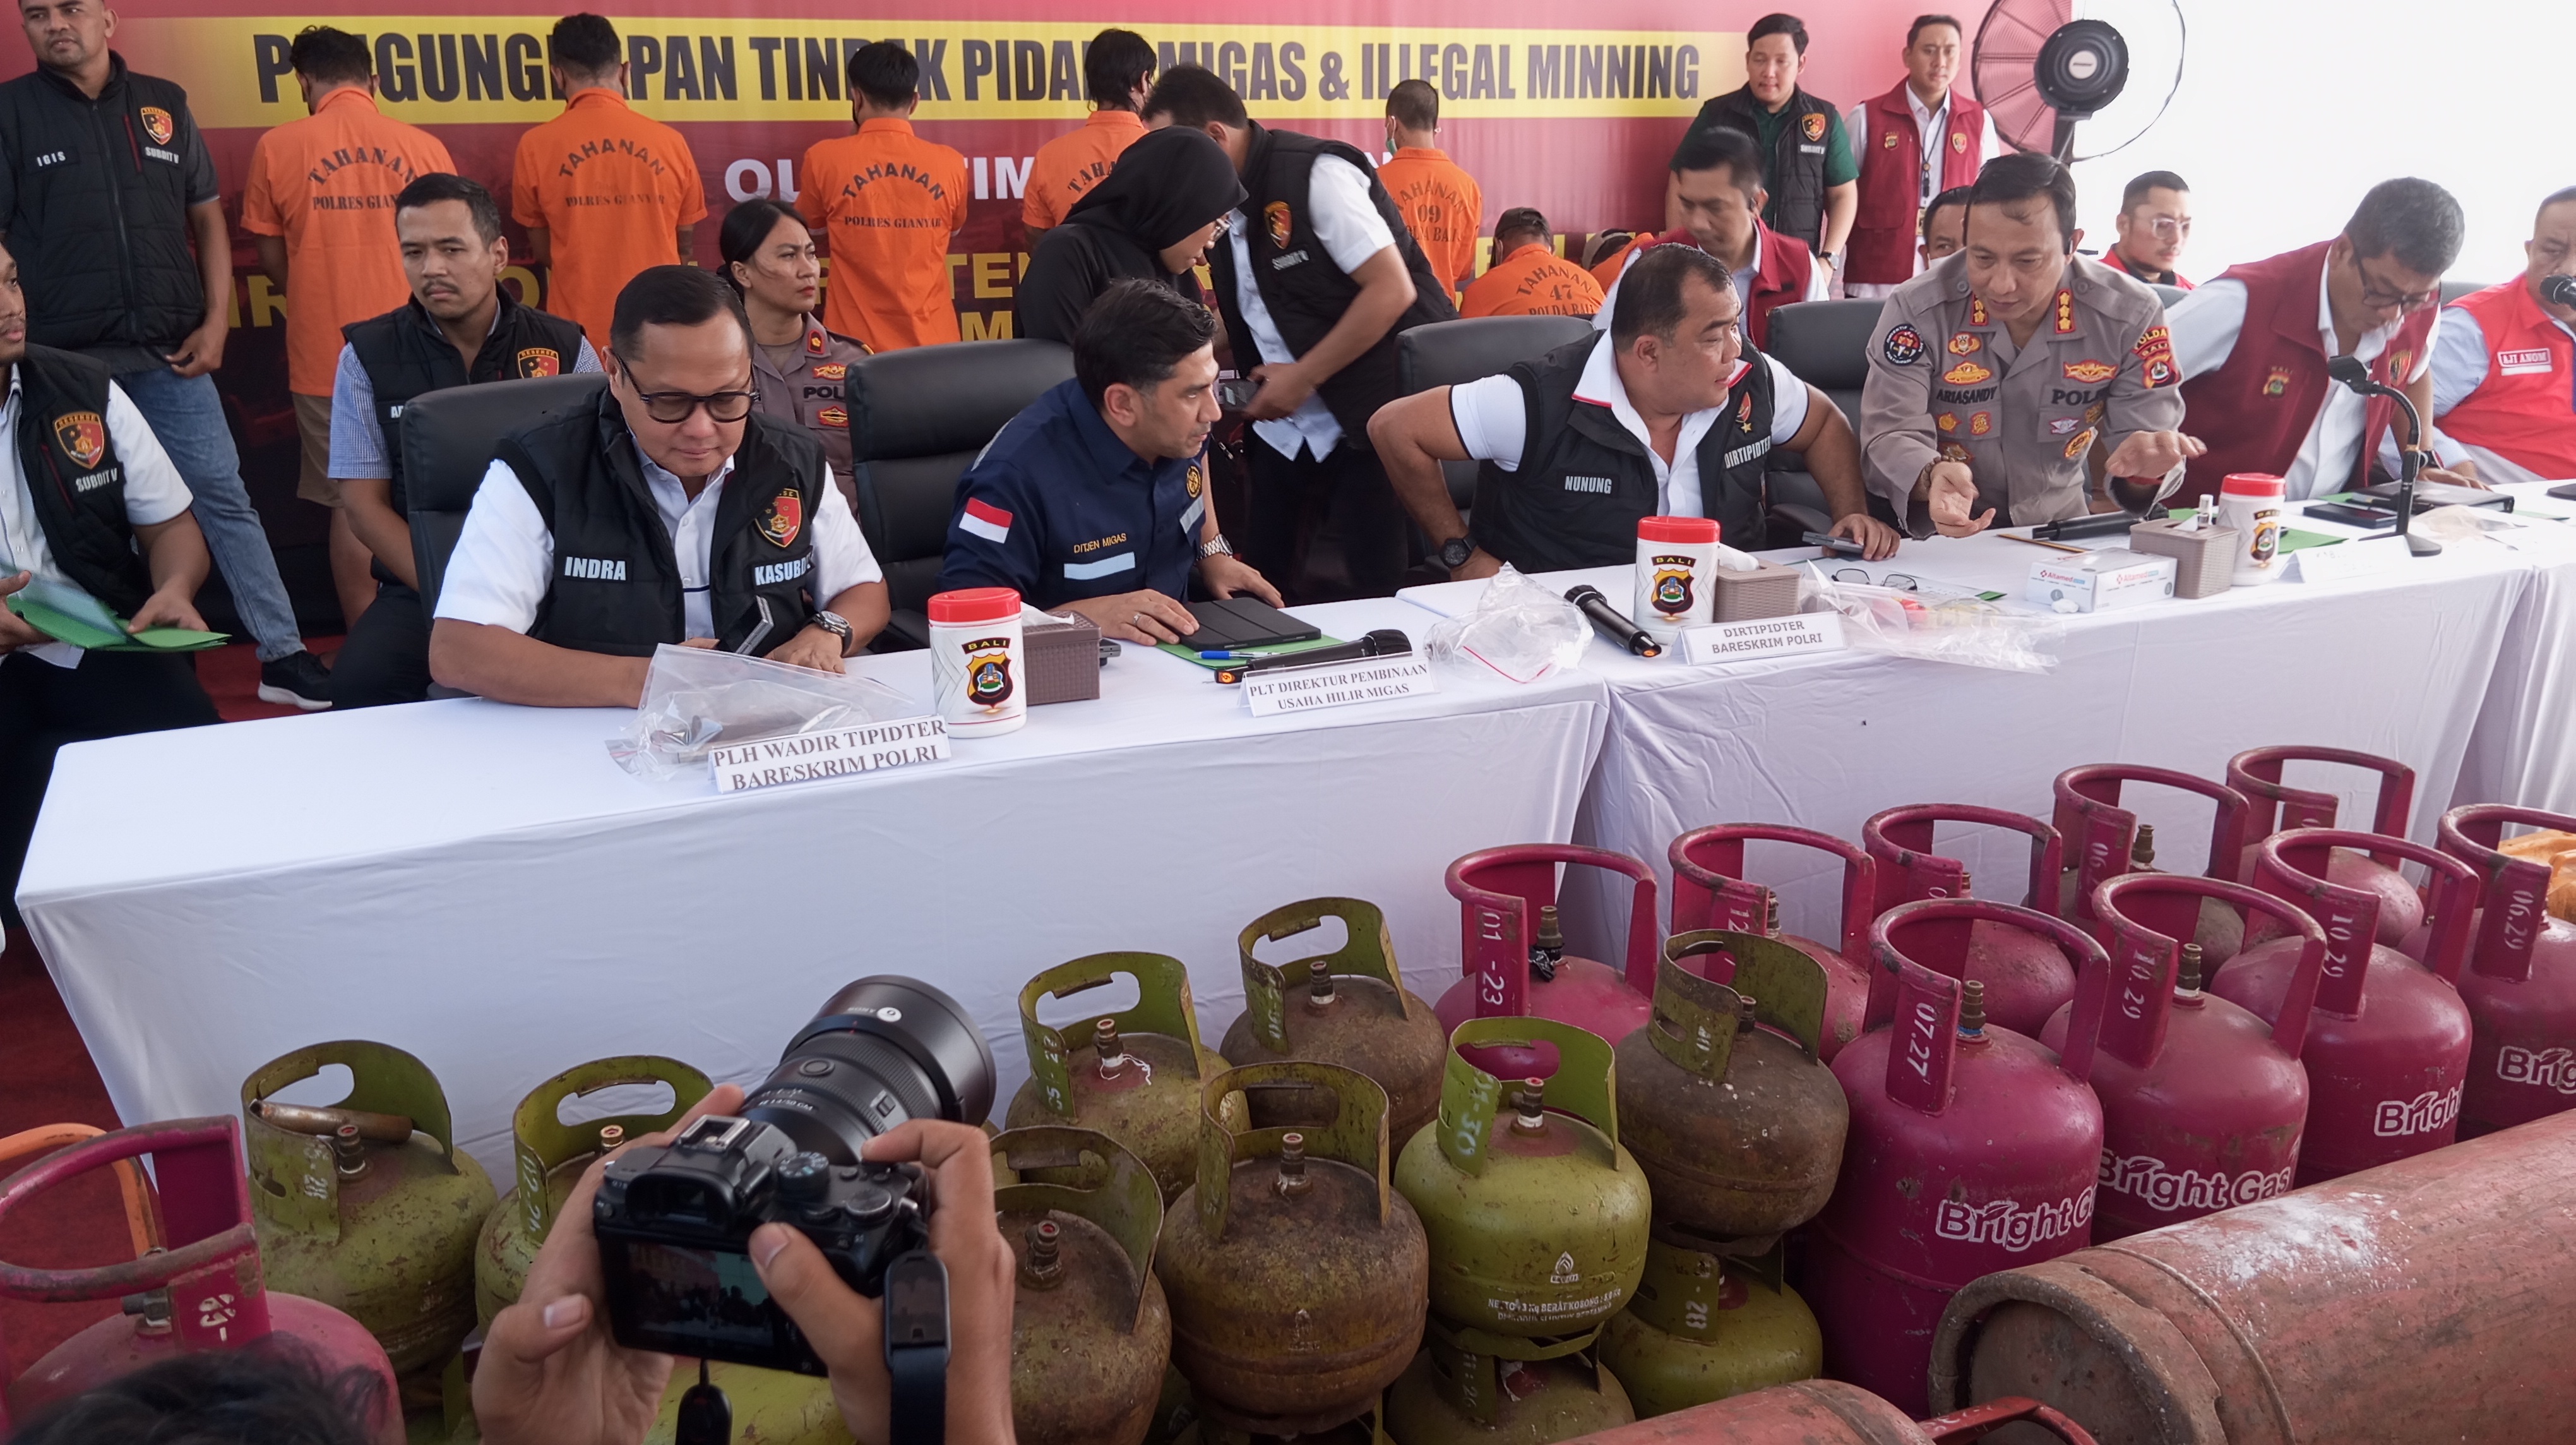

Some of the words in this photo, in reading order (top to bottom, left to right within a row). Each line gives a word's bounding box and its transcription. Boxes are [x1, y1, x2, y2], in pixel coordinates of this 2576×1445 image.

[1318, 51, 1349, 101] &
[1527, 44, 1699, 100] MINNING
[37, 152, 66, 167] IGIS
[559, 138, 665, 177] TAHANAN
[842, 162, 945, 201] TAHANAN
[313, 196, 363, 210] POLRES
[1417, 204, 1441, 224] 09
[844, 216, 890, 227] POLRES
[1517, 264, 1592, 296] TAHANAN
[1549, 284, 1573, 301] 47
[1936, 386, 1998, 405] ARIASANDY
[76, 470, 110, 492] SUBDIT
[110, 467, 117, 481] V
[1565, 476, 1613, 494] NUNUNG
[1074, 541, 1100, 553] DITJEN
[1102, 533, 1127, 548] MIGAS
[564, 556, 627, 580] INDRA
[1655, 556, 1691, 565] BALI
[2048, 572, 2073, 582] Altamed
[1724, 621, 1805, 638] DIRTIPIDTER
[968, 640, 1007, 651] BALI
[1712, 636, 1784, 654] BARESKRIM
[1787, 633, 1823, 646] POLRI
[1250, 683, 1275, 697] PLT
[1279, 674, 1348, 693] DIREKTUR
[1351, 664, 1428, 683] PEMBINAAN
[1278, 695, 1323, 709] USAHA
[1327, 690, 1364, 703] HILIR
[1367, 683, 1409, 697] MIGAS
[714, 746, 757, 767] PLH
[764, 734, 841, 759] WADIR
[843, 719, 947, 748] TIPIDTER
[732, 755, 866, 789] BARESKRIM
[873, 744, 939, 770] POLRI
[2504, 890, 2534, 950] 06.29
[2122, 949, 2156, 1019] 10.29
[1907, 1003, 1936, 1077] 07.27
[2098, 1149, 2228, 1211] Bright
[2230, 1166, 2291, 1207] Gas
[1936, 1199, 2073, 1252] Bright
